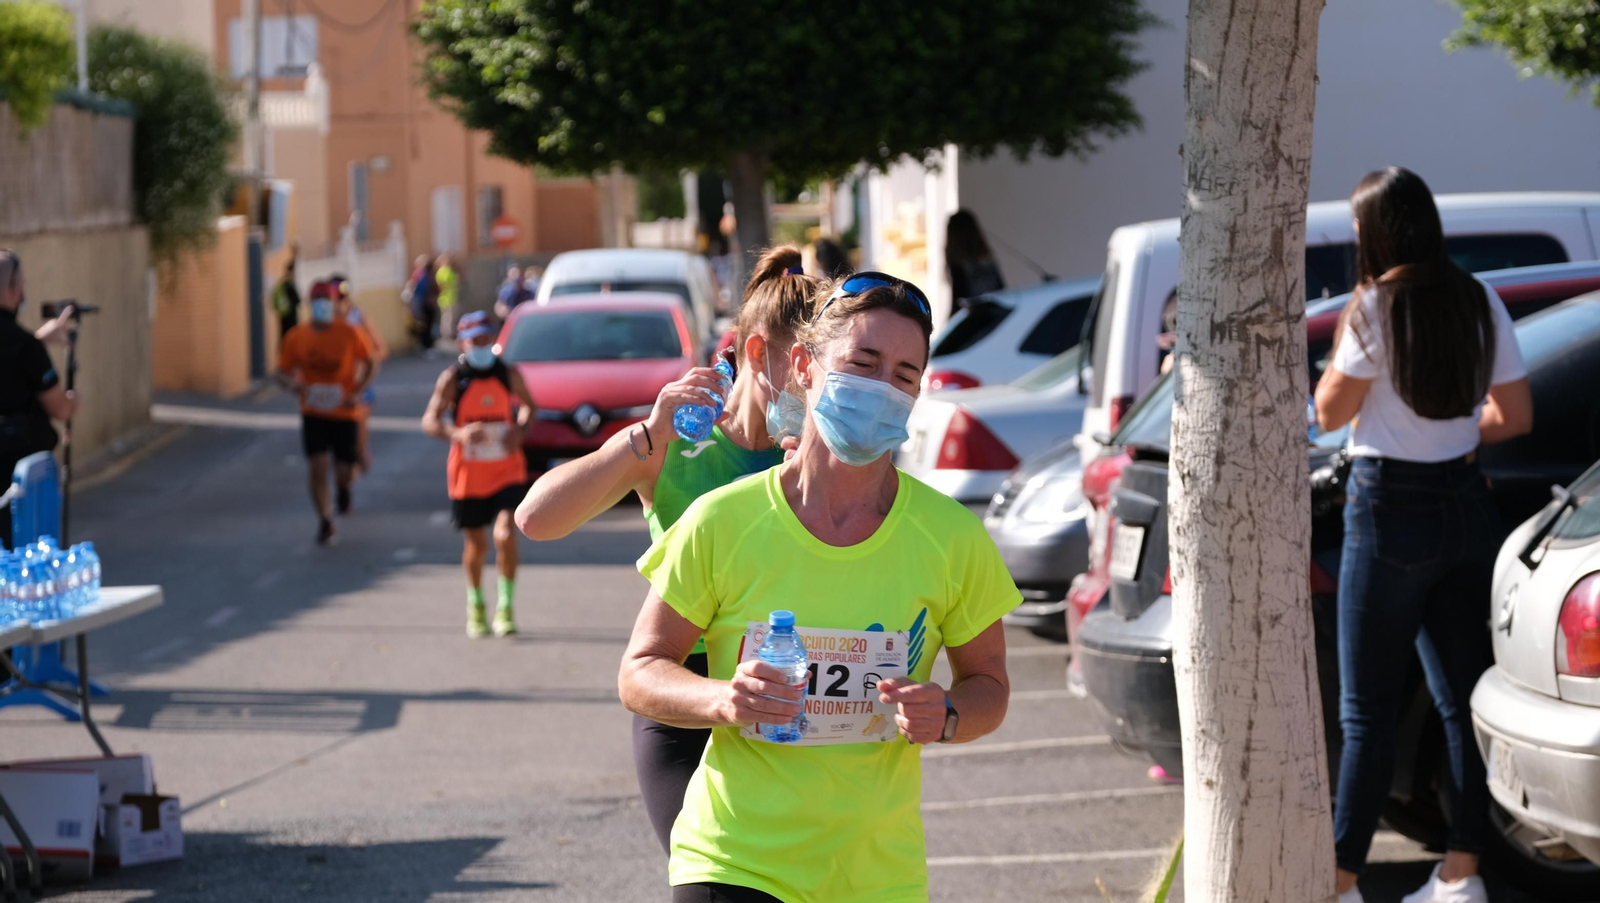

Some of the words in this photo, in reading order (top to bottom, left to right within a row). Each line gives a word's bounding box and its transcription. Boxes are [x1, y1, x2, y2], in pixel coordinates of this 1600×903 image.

[838, 637, 867, 653] 2020
[806, 651, 823, 662] RAS
[825, 652, 867, 664] POPULARES
